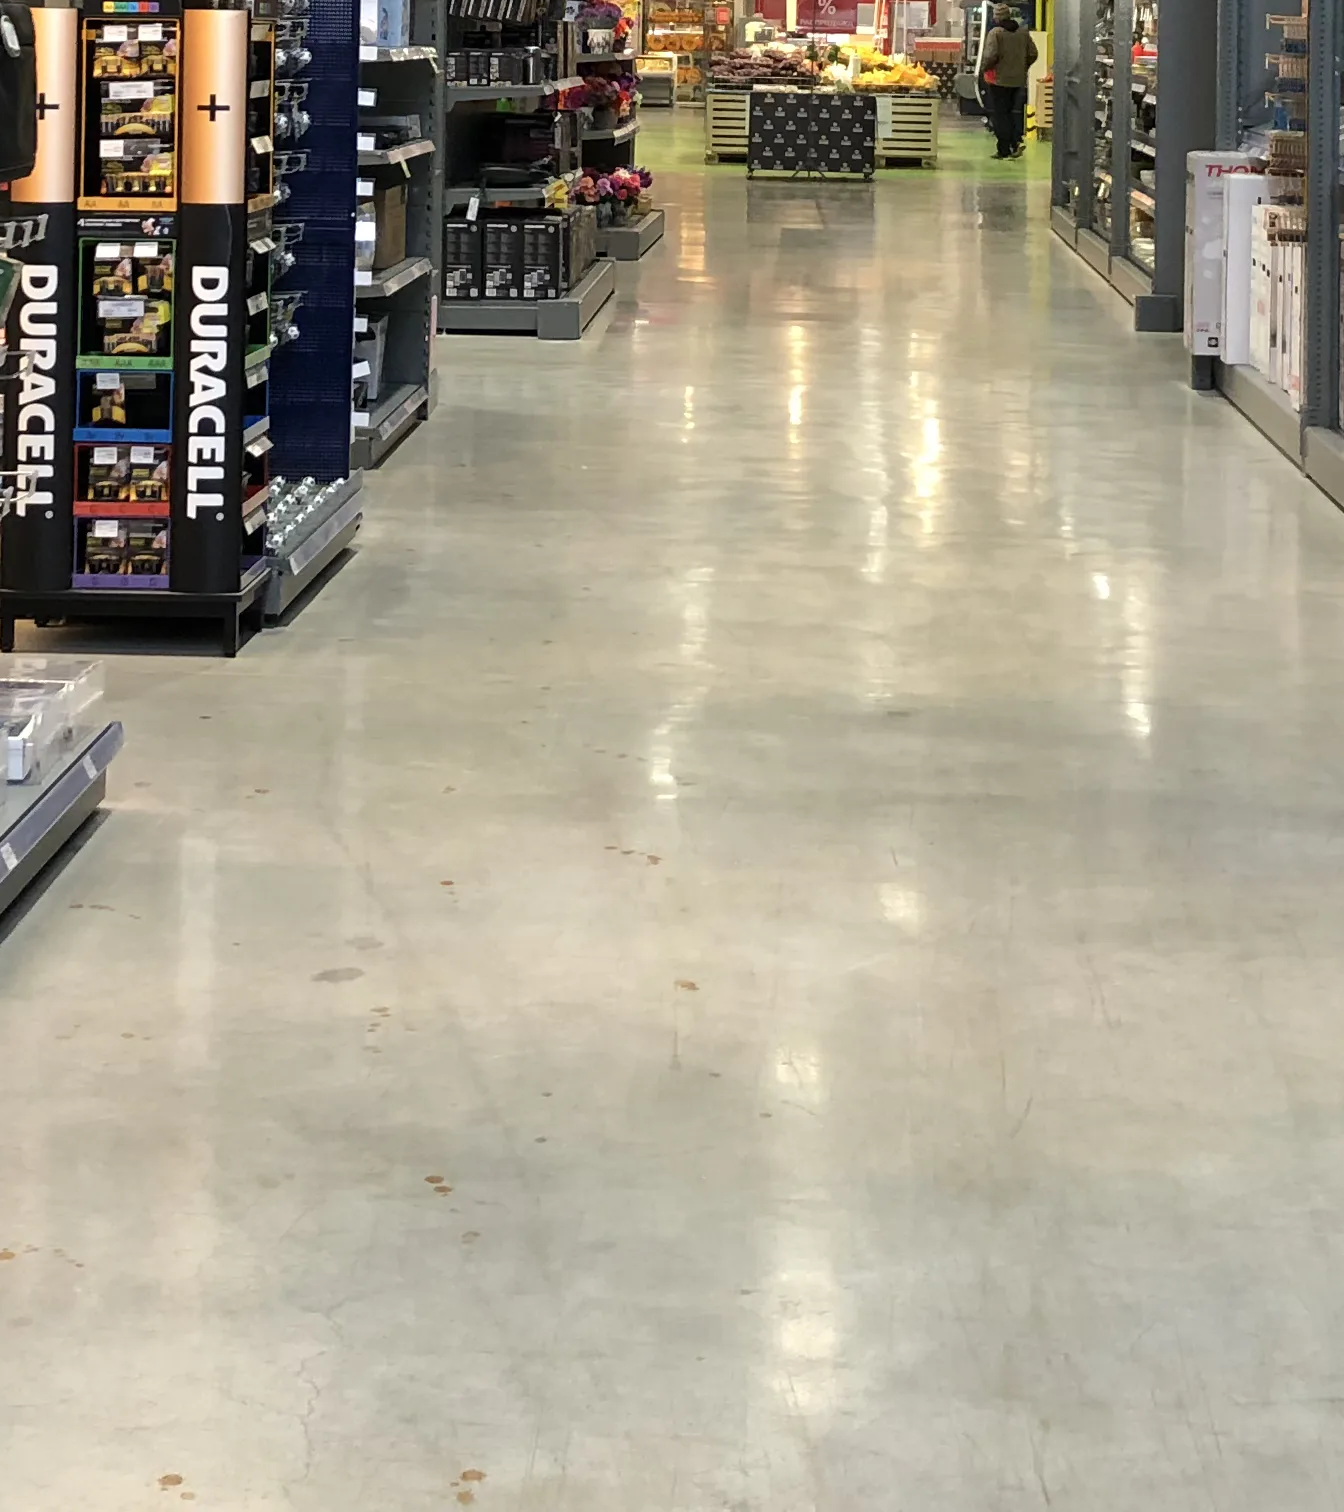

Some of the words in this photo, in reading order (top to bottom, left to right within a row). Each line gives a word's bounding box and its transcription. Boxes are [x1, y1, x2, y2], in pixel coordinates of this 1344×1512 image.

[1205, 164, 1266, 177] THOM
[16, 264, 58, 518] DURACELL
[186, 265, 230, 520] DURACELL
